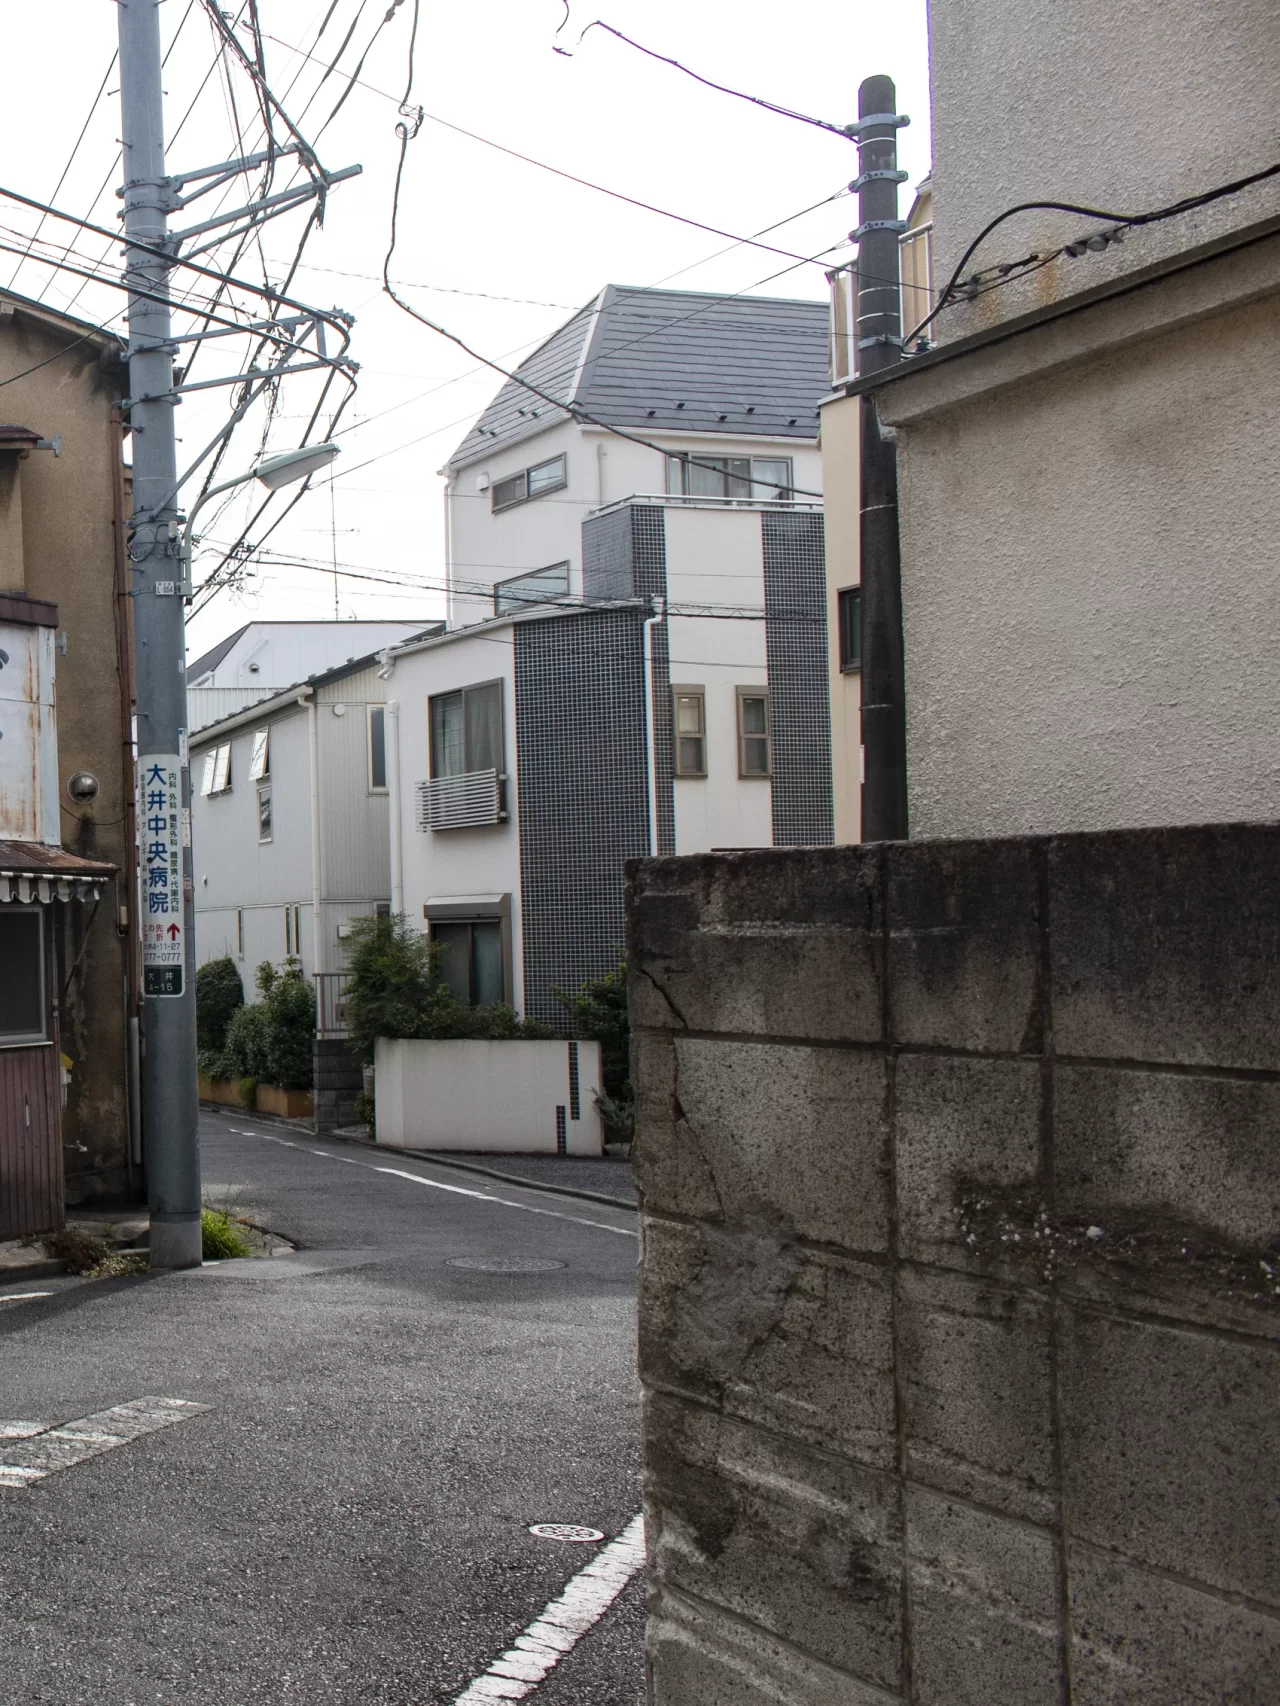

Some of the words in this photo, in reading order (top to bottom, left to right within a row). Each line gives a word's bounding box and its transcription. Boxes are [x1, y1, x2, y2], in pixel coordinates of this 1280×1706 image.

[168, 772, 177, 788] 内科
[168, 793, 177, 810] 外科
[146, 763, 169, 914] 大井中央病院
